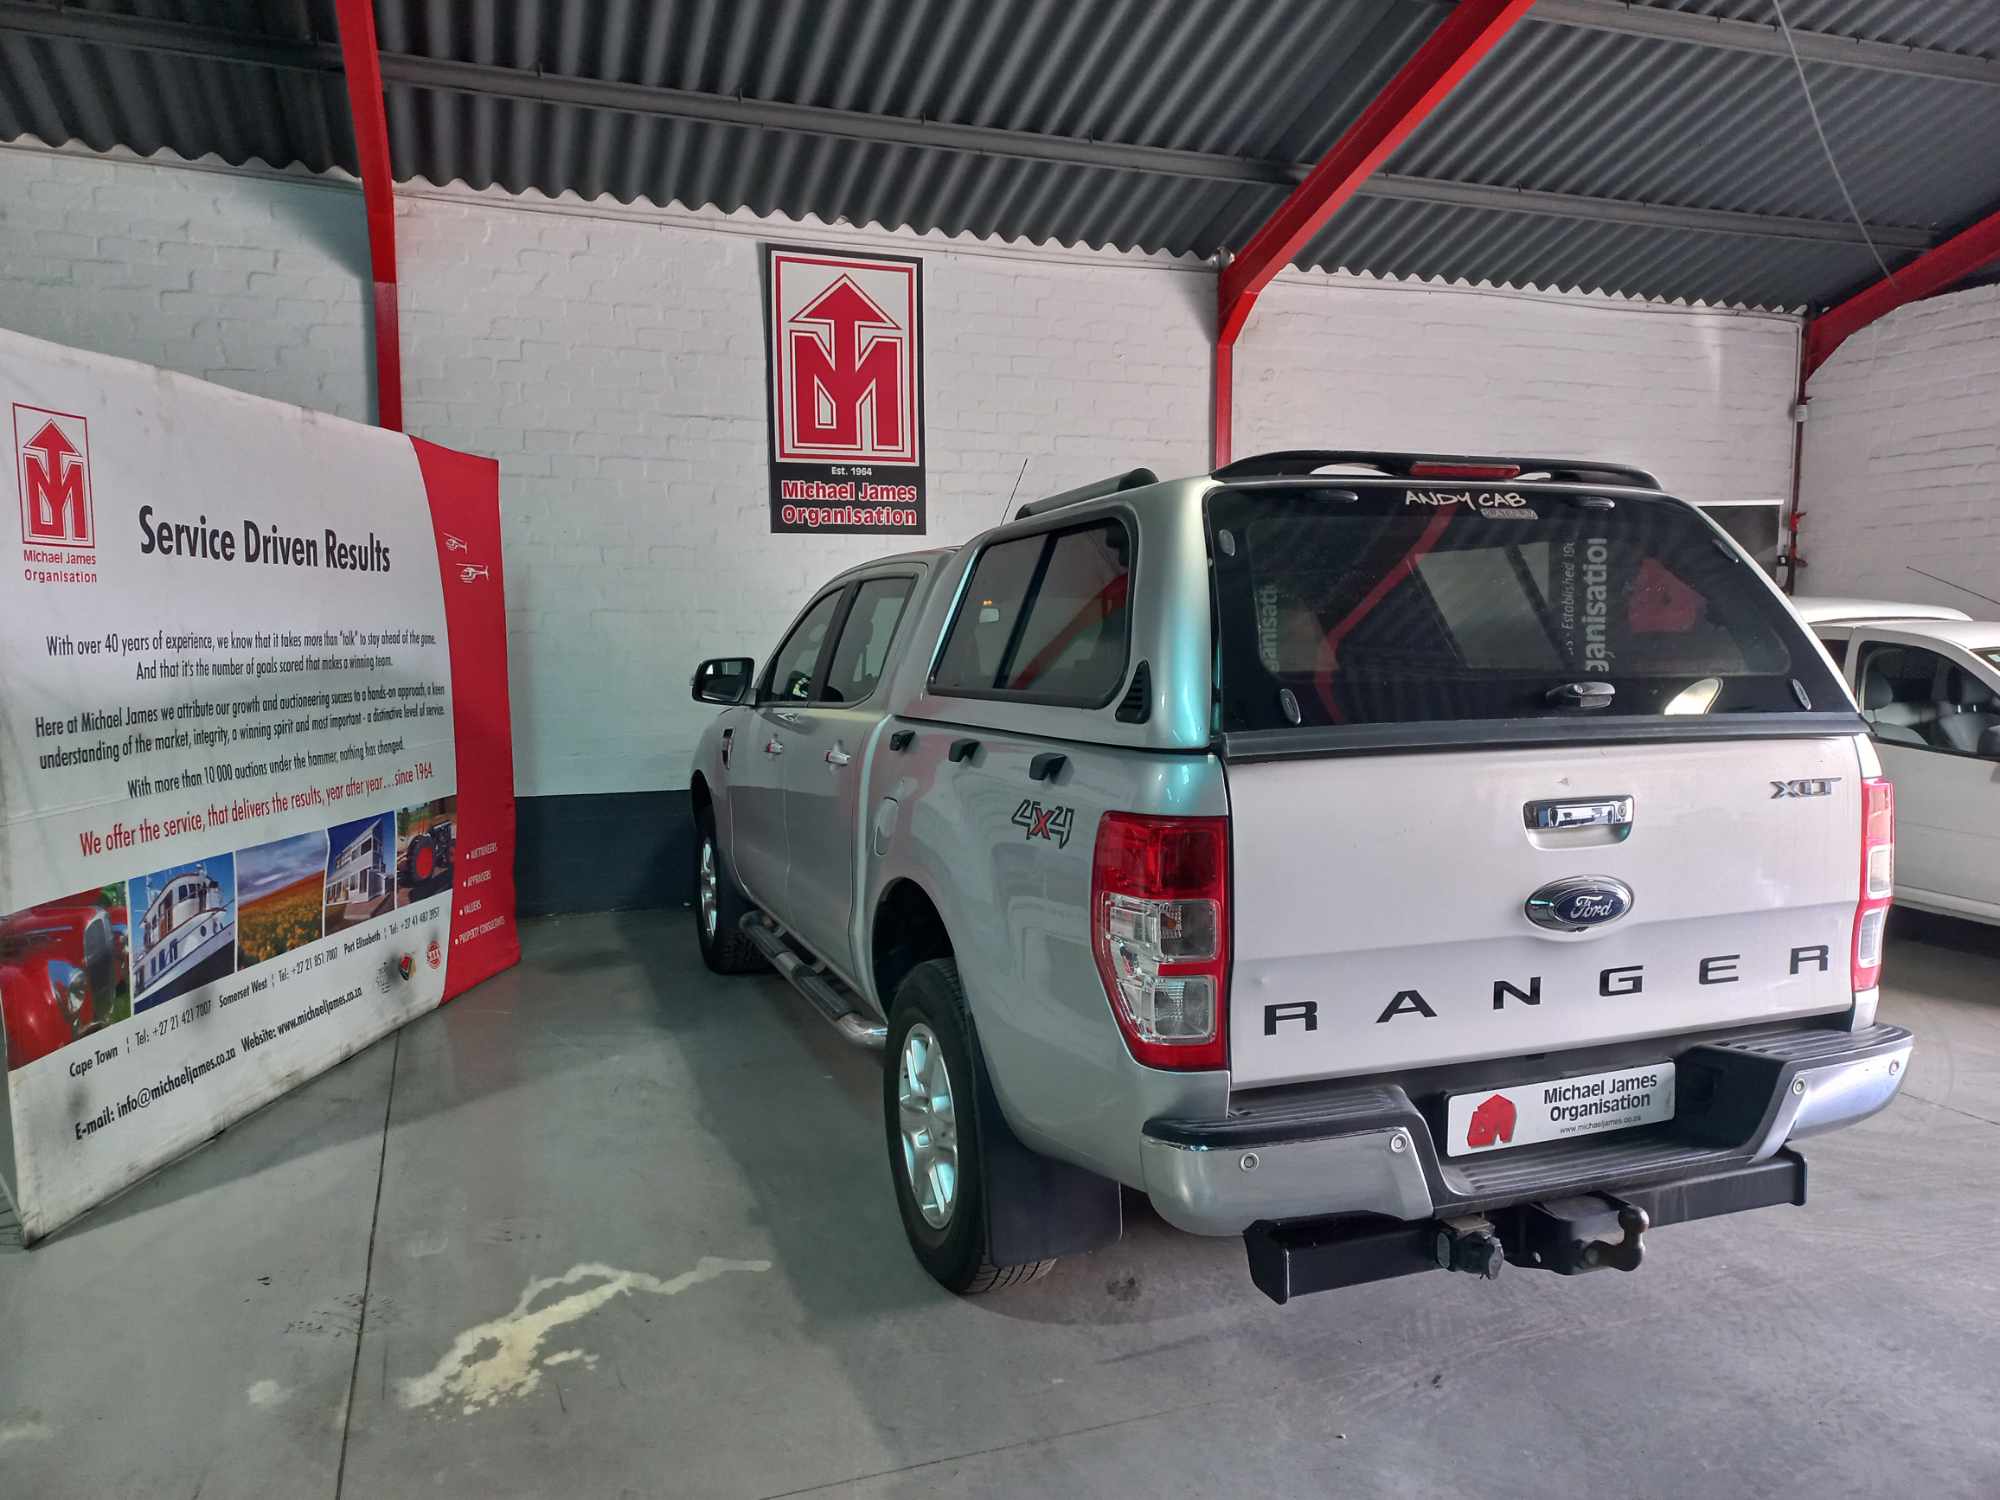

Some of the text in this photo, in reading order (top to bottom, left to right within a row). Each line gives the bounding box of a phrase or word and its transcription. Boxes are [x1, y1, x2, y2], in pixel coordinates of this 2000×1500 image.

[831, 466, 872, 476] Est. 1964
[782, 480, 917, 502] Michael James
[1405, 490, 1527, 511] ANDY CAB
[782, 504, 917, 527] Organisation
[138, 504, 391, 573] Service Driven Results
[24, 549, 96, 565] Michael James
[24, 568, 97, 584] Organisation
[46, 635, 73, 656] With
[78, 640, 101, 655] over
[105, 633, 119, 653] 40
[122, 636, 149, 656] years
[153, 630, 163, 650] of
[166, 632, 214, 653] experience,
[217, 638, 228, 649] we
[231, 631, 253, 649] know
[255, 631, 271, 649] that
[273, 632, 278, 648] it
[281, 630, 302, 648] takes
[304, 635, 323, 647] more
[324, 630, 338, 646] than
[360, 632, 366, 646] to
[368, 632, 380, 648] stay
[381, 629, 401, 645] ahead
[402, 629, 408, 644] of
[410, 629, 420, 645] the
[136, 659, 156, 680] And
[160, 657, 179, 678] that
[182, 660, 194, 677] it's
[196, 658, 209, 676] the
[212, 657, 244, 676] number
[246, 657, 254, 675] of
[257, 656, 278, 678] goals
[280, 655, 304, 673] scored
[306, 654, 320, 671] that
[322, 654, 343, 670] makes
[344, 659, 348, 669] a
[349, 654, 375, 671] winning
[35, 715, 64, 738] Here
[67, 717, 78, 734] at
[81, 707, 123, 732] Michael
[125, 706, 158, 726] James
[161, 707, 174, 721] we
[177, 699, 214, 719] attribute
[216, 703, 230, 716] our
[232, 695, 260, 718] growth
[263, 693, 278, 711] and
[280, 690, 330, 709] auctioneering
[331, 692, 353, 705] success
[353, 689, 360, 701] to
[362, 690, 367, 702] a
[368, 683, 396, 701] hands-on
[40, 740, 120, 769] understanding
[122, 735, 133, 756] of
[135, 733, 152, 754] the
[155, 728, 191, 751] market,
[194, 725, 230, 747] integrity,
[232, 728, 237, 741] a
[240, 723, 271, 741] winning
[274, 719, 294, 739] spirit
[296, 714, 309, 733] and
[312, 715, 328, 731] most
[330, 712, 361, 731] important
[367, 712, 371, 723] a
[404, 702, 418, 718] level
[128, 776, 151, 798] With
[155, 776, 180, 793] more
[182, 769, 202, 788] than
[205, 765, 215, 784] 10
[217, 764, 233, 781] 000
[235, 761, 267, 780] auctions
[270, 753, 292, 774] under
[294, 752, 306, 769] the
[308, 749, 338, 766] hammer,
[340, 744, 364, 762] nothing
[365, 741, 376, 755] has
[80, 831, 101, 857] We
[106, 822, 136, 850] offer
[139, 818, 160, 843] the
[163, 811, 206, 838] service,
[208, 804, 229, 827] that
[232, 795, 270, 822] delivers
[272, 792, 288, 814] the
[291, 785, 325, 809] results,
[326, 785, 343, 806] year
[346, 777, 364, 797] after
[415, 762, 433, 781] 1964
[1570, 895, 1613, 919] Ford
[69, 1058, 93, 1077] Cape
[95, 1047, 118, 1067] Town
[135, 1028, 149, 1046] Tel:
[153, 1019, 168, 1036] +27
[170, 1015, 179, 1031] 21
[182, 1008, 194, 1025] 421
[218, 985, 249, 1008] Somerset
[251, 978, 267, 994] West
[278, 968, 289, 982] Tel:
[292, 960, 304, 975] +27
[305, 958, 313, 971] 21
[344, 941, 355, 955] Port
[356, 929, 381, 950] Elizabeth
[1263, 944, 1830, 1037] RANGER
[75, 985, 363, 1141] E-mail: info@michaeljames.co.za Website: www.michaeljames.co.za
[1543, 1074, 1657, 1104] Michael James
[1550, 1092, 1651, 1122] Organisation
